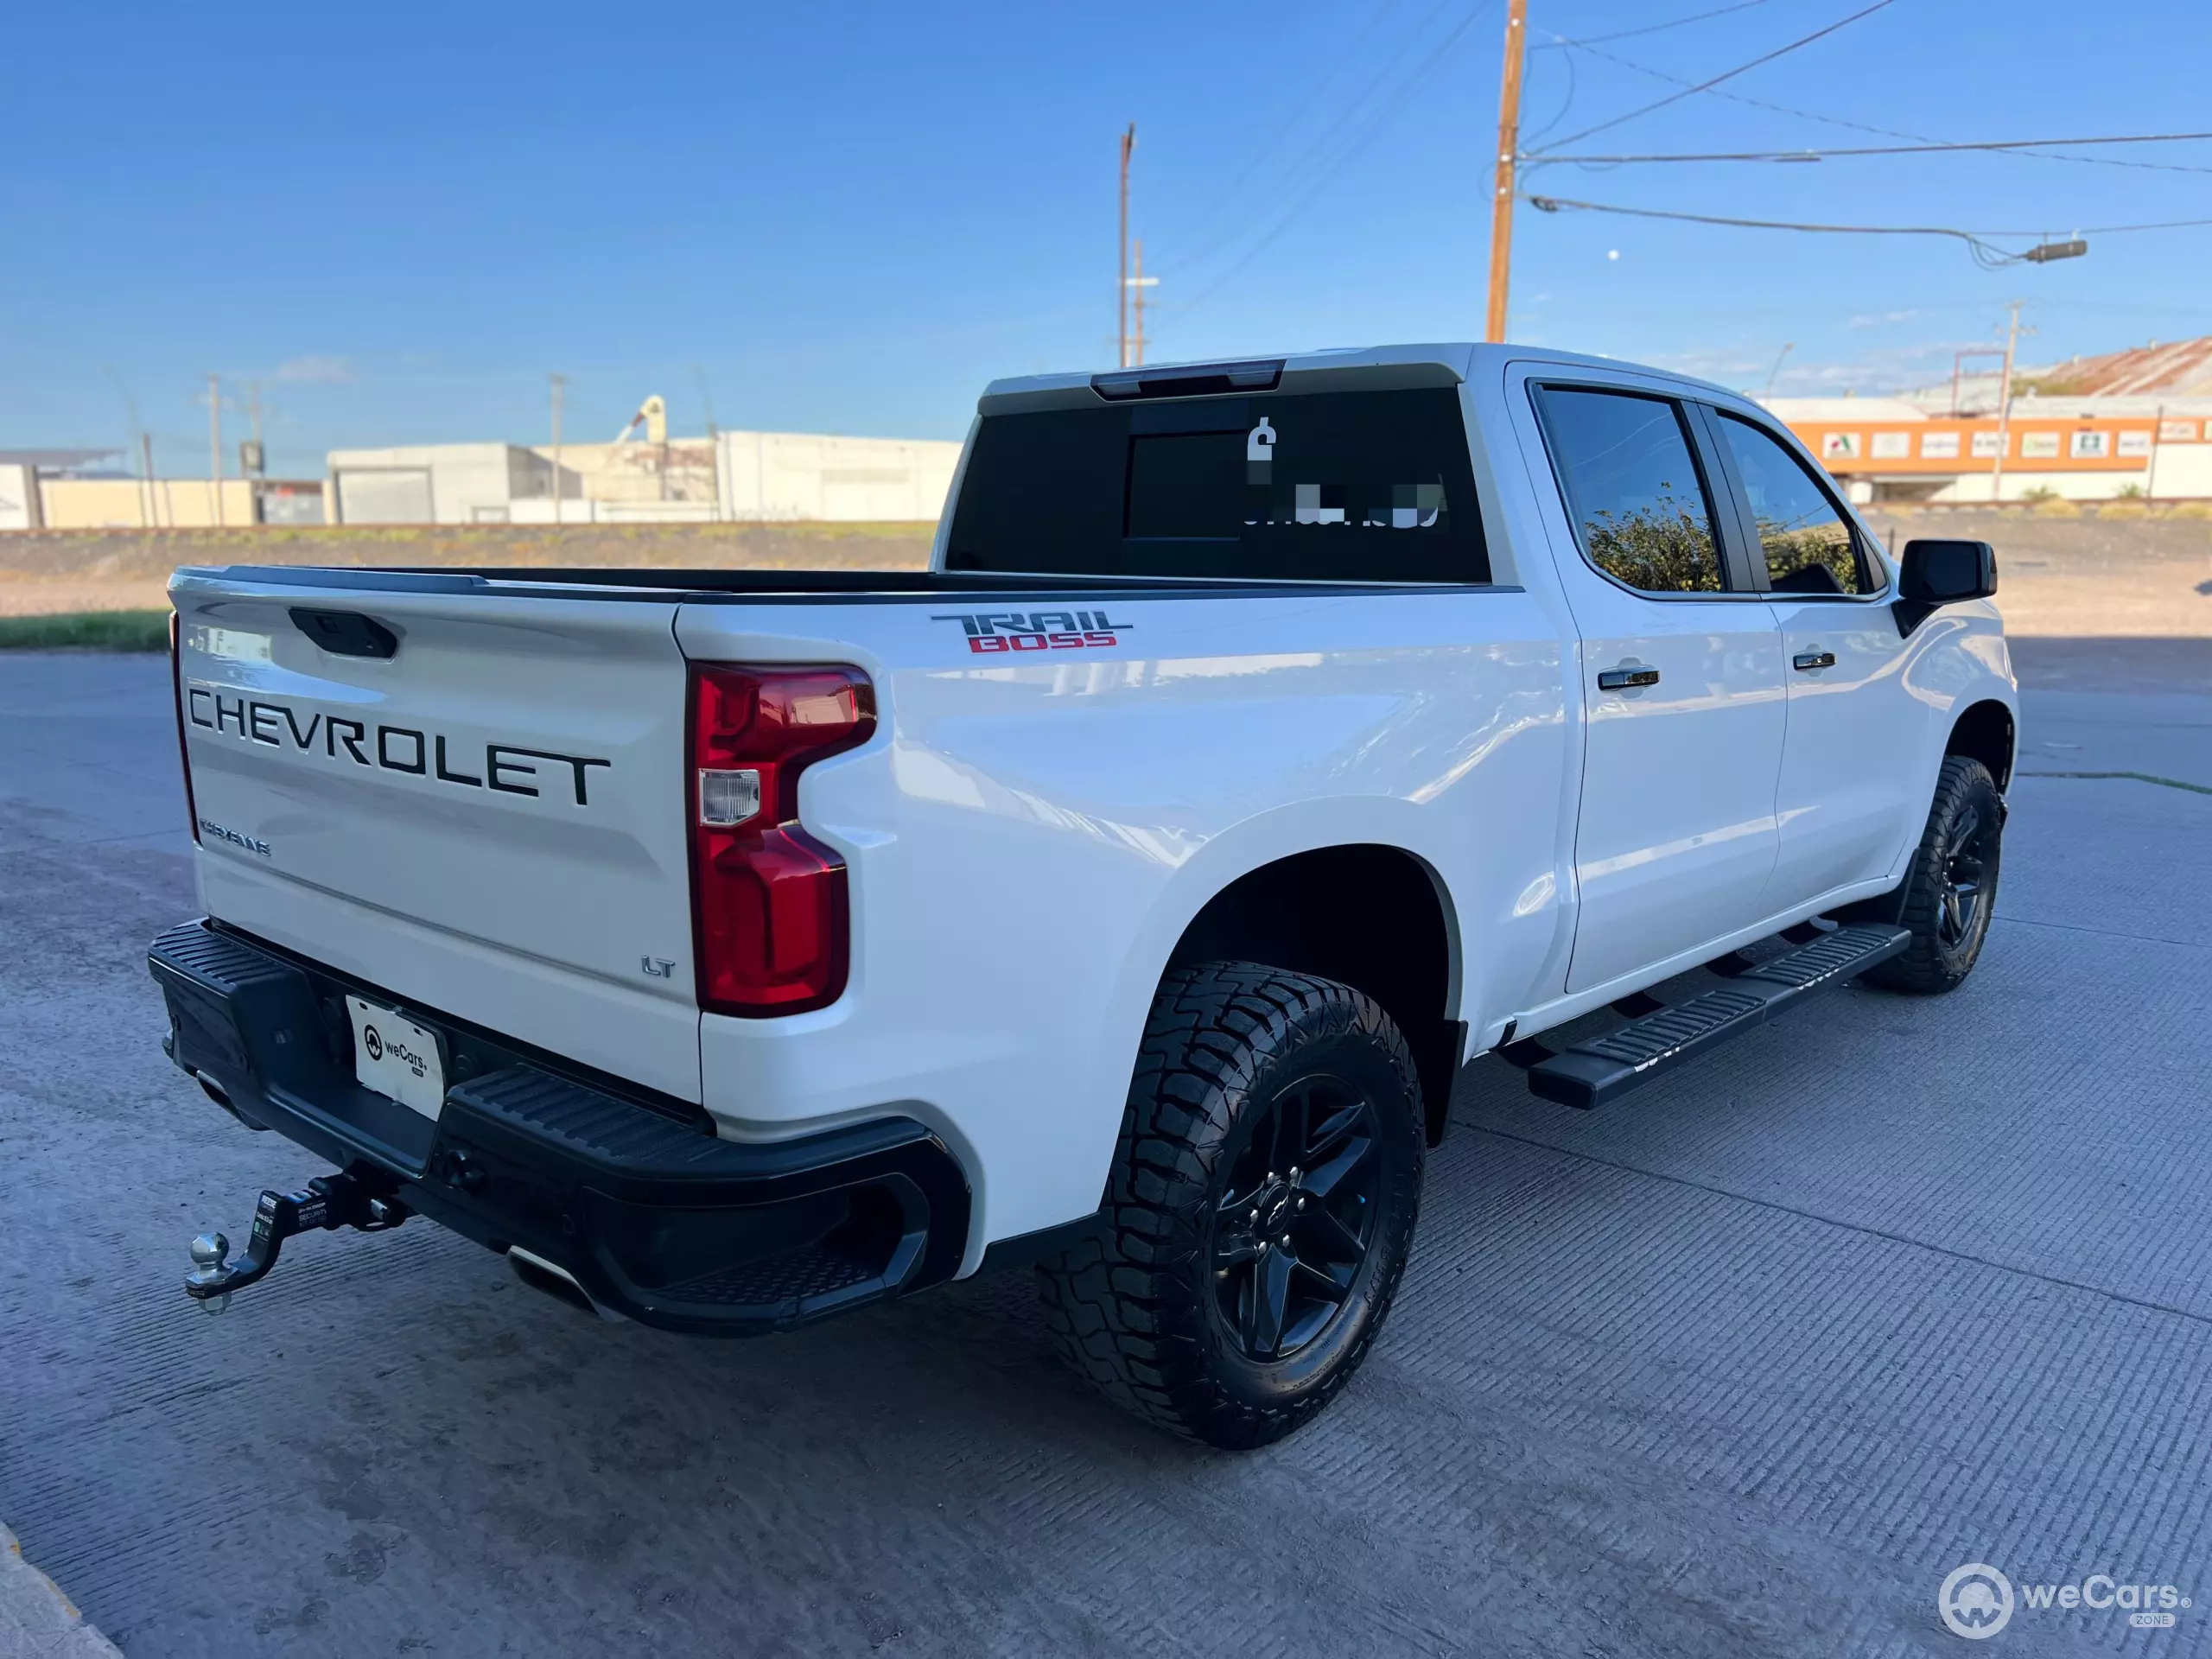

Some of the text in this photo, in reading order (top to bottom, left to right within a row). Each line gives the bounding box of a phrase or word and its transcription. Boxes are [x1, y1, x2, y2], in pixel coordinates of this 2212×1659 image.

[930, 611, 1134, 635] TRAIL
[967, 631, 1117, 653] BOSS
[188, 688, 611, 806] CHEVROLET
[641, 955, 676, 978] LT
[385, 1040, 423, 1069] weCars
